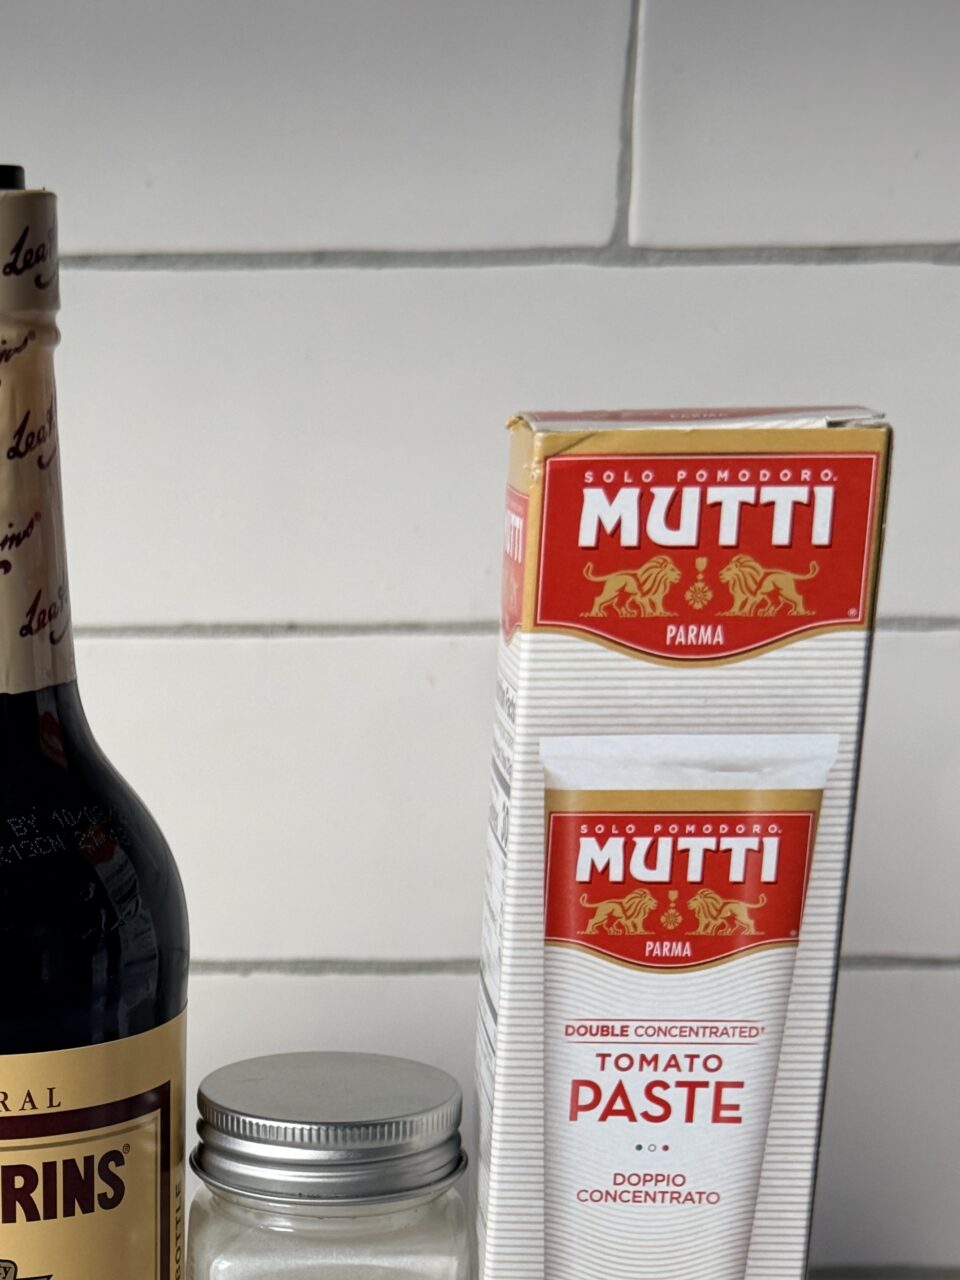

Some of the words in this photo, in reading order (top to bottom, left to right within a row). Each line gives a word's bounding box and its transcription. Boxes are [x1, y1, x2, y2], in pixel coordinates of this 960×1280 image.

[584, 469, 655, 484] SOLO
[577, 486, 835, 548] MUTTI
[666, 624, 725, 646] PARMA
[580, 824, 636, 834] SOLO
[575, 836, 780, 883] MUTTI
[645, 941, 691, 957] PARMA
[564, 1024, 630, 1038] DOUBLE
[596, 1053, 723, 1073] TOMATO
[569, 1079, 745, 1124] PASTE
[613, 1172, 686, 1188] DOPPIO
[576, 1189, 720, 1205] CONCENTRATO
